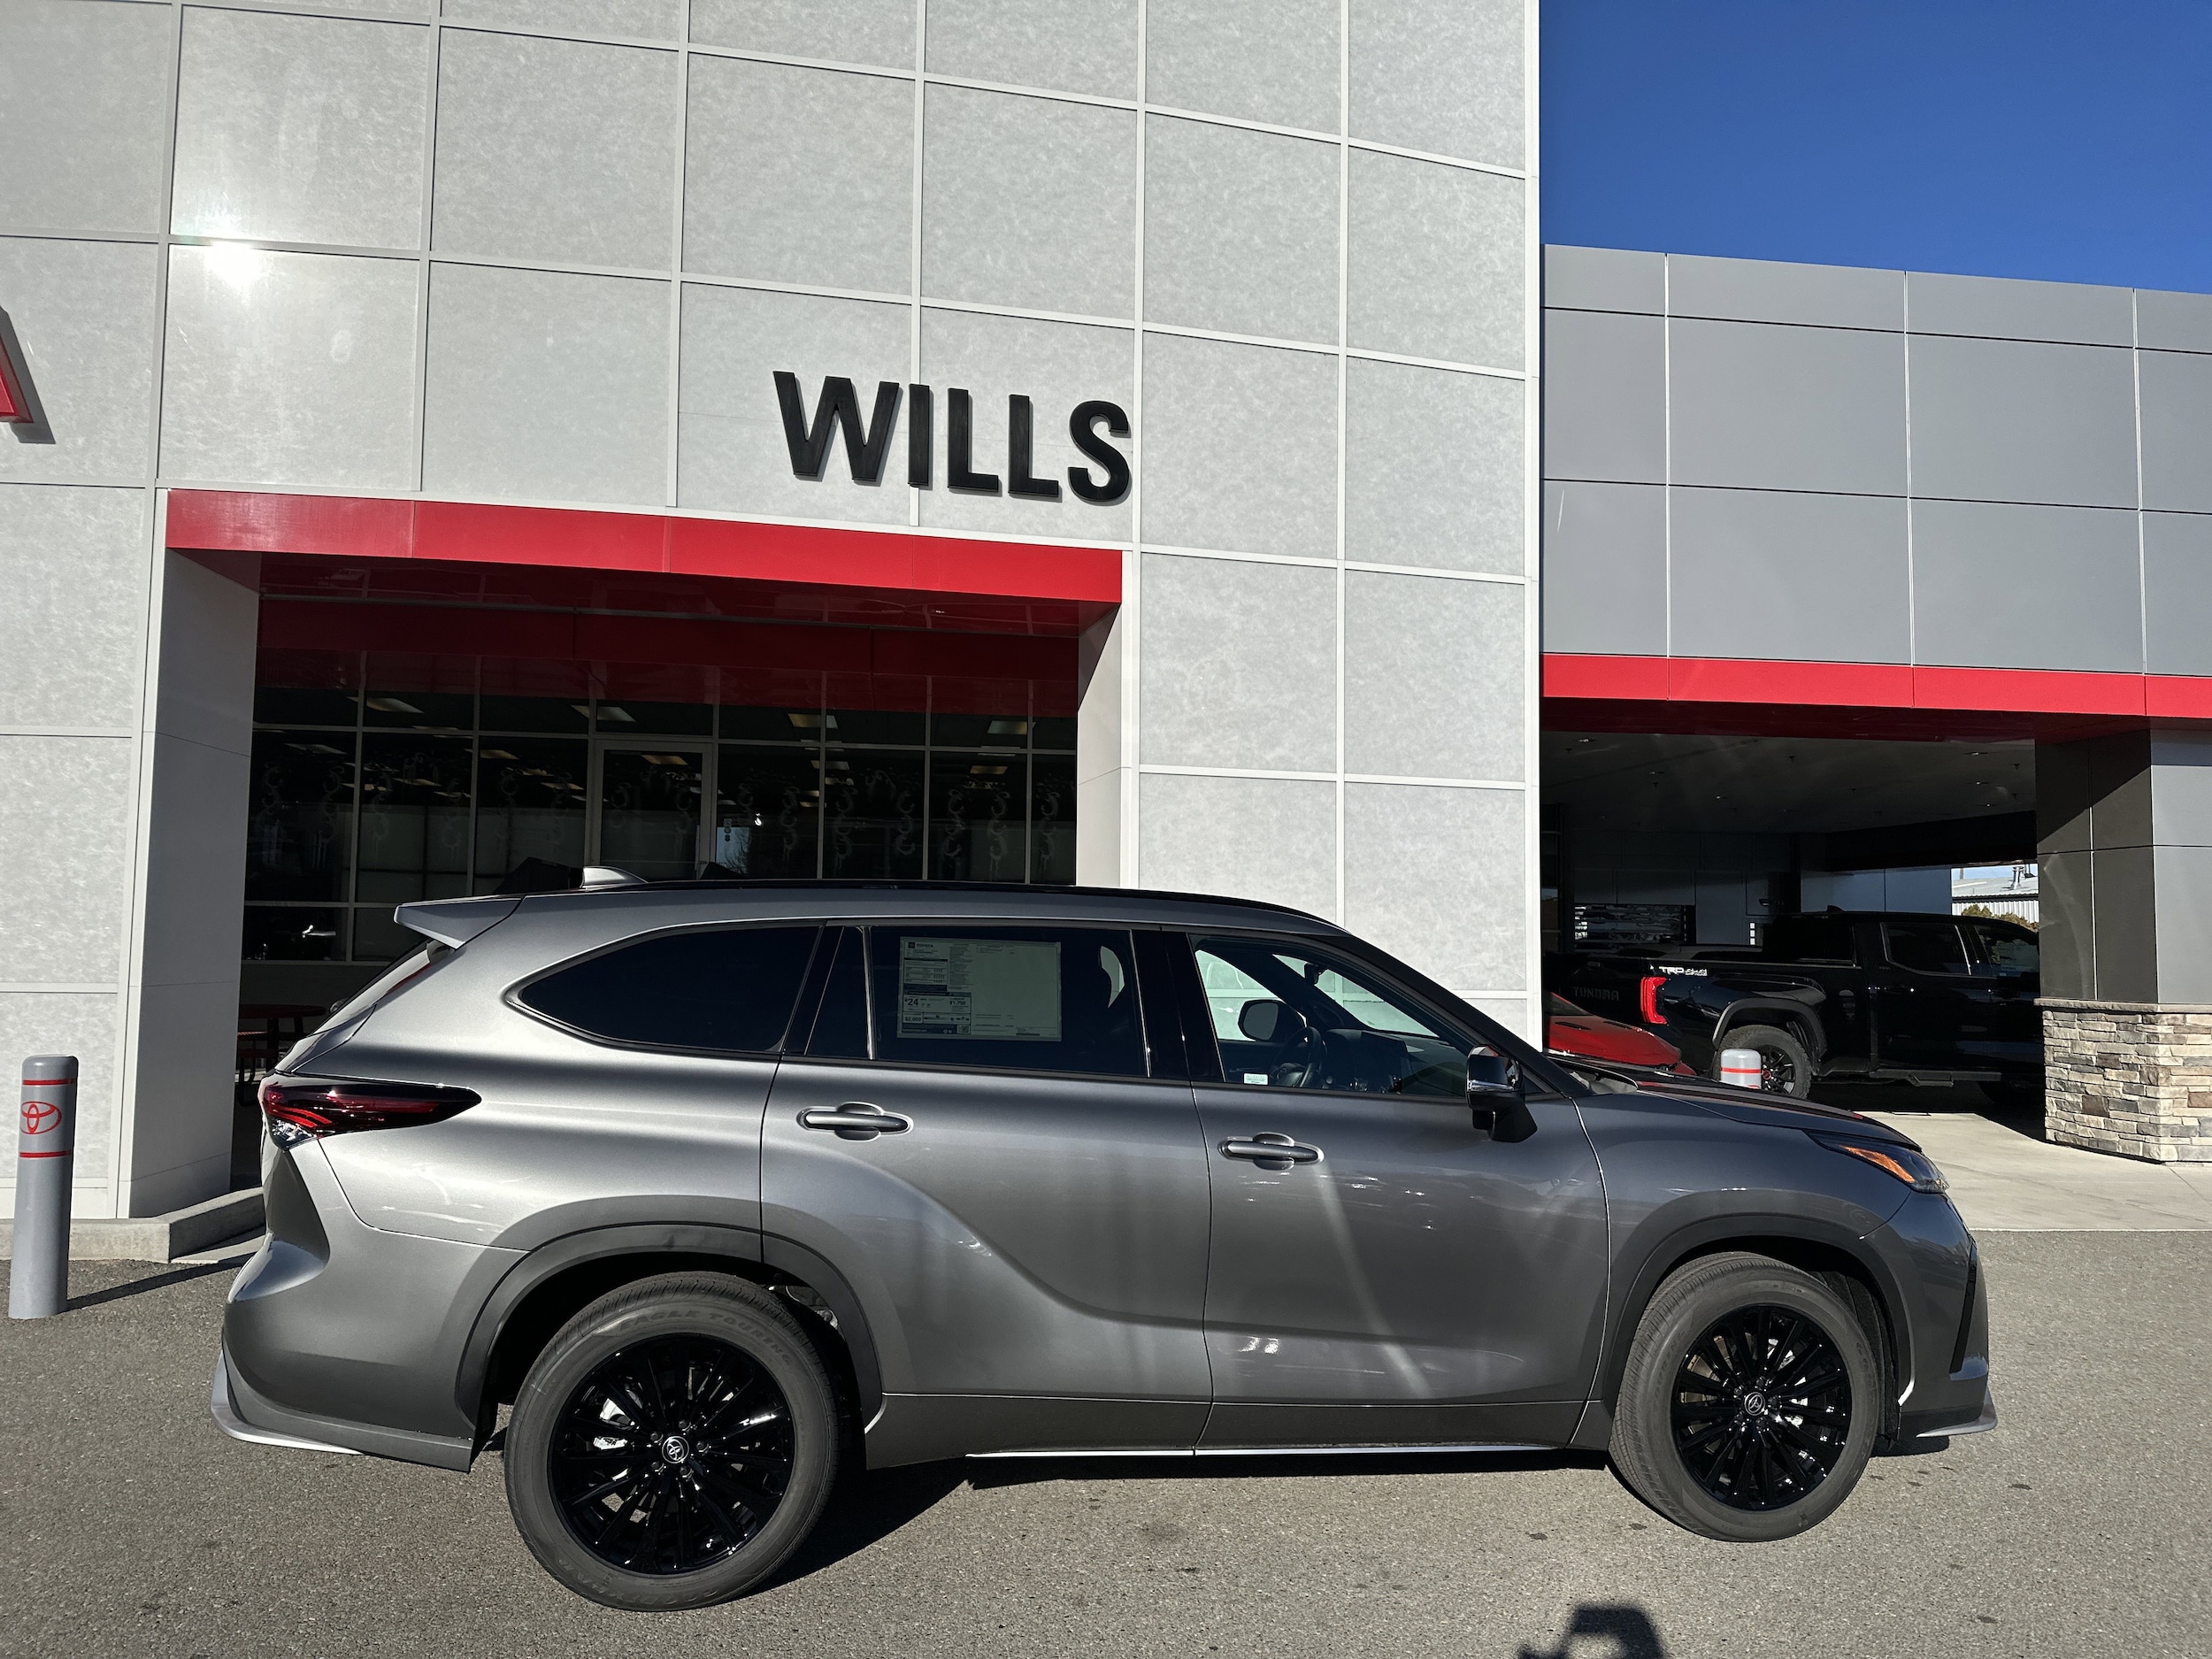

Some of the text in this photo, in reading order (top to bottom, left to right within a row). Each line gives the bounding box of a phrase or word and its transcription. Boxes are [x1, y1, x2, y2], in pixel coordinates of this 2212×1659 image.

[773, 371, 1130, 503] WILLS
[1573, 987, 1619, 1002] TUNDRA
[618, 1310, 795, 1364] EAGLE TOURING
